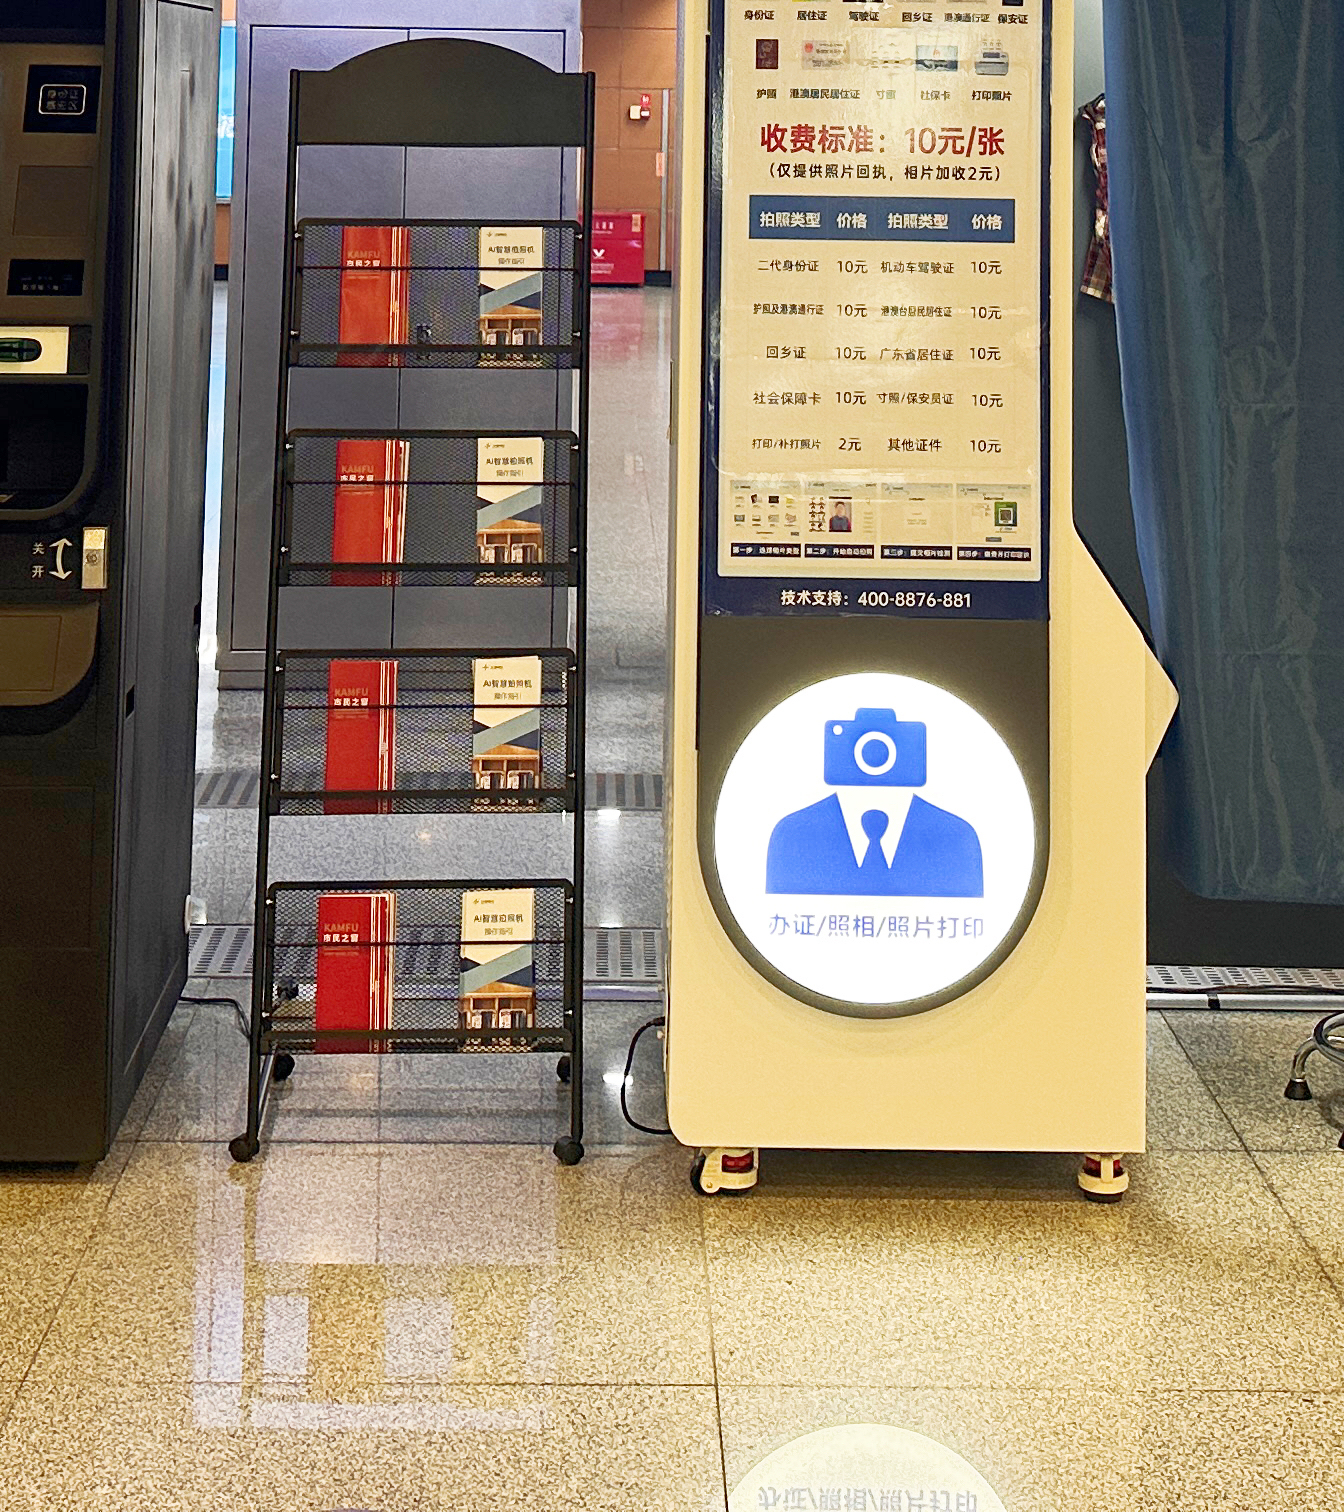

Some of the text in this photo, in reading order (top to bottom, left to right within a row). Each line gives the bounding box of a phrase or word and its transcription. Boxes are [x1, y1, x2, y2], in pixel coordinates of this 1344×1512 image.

[759, 211, 1003, 231] 拍照类型 价格 拍照类型 价格
[757, 259, 820, 272] 二代身份证
[837, 260, 869, 274] 10元
[971, 261, 1003, 275] 10元
[836, 303, 868, 318] 10元
[970, 306, 1002, 320] 10元
[766, 345, 807, 359] 回乡证
[835, 346, 867, 361] 10元
[969, 346, 1001, 361] 10元
[835, 391, 867, 405] 10元
[971, 393, 1004, 408] 10元
[838, 437, 862, 452] 2元
[887, 437, 943, 453] 其他证件
[970, 439, 1002, 453] 10元
[31, 541, 45, 555] 关
[31, 565, 45, 579] 开
[768, 913, 985, 939] 办证/照相/照片打印
